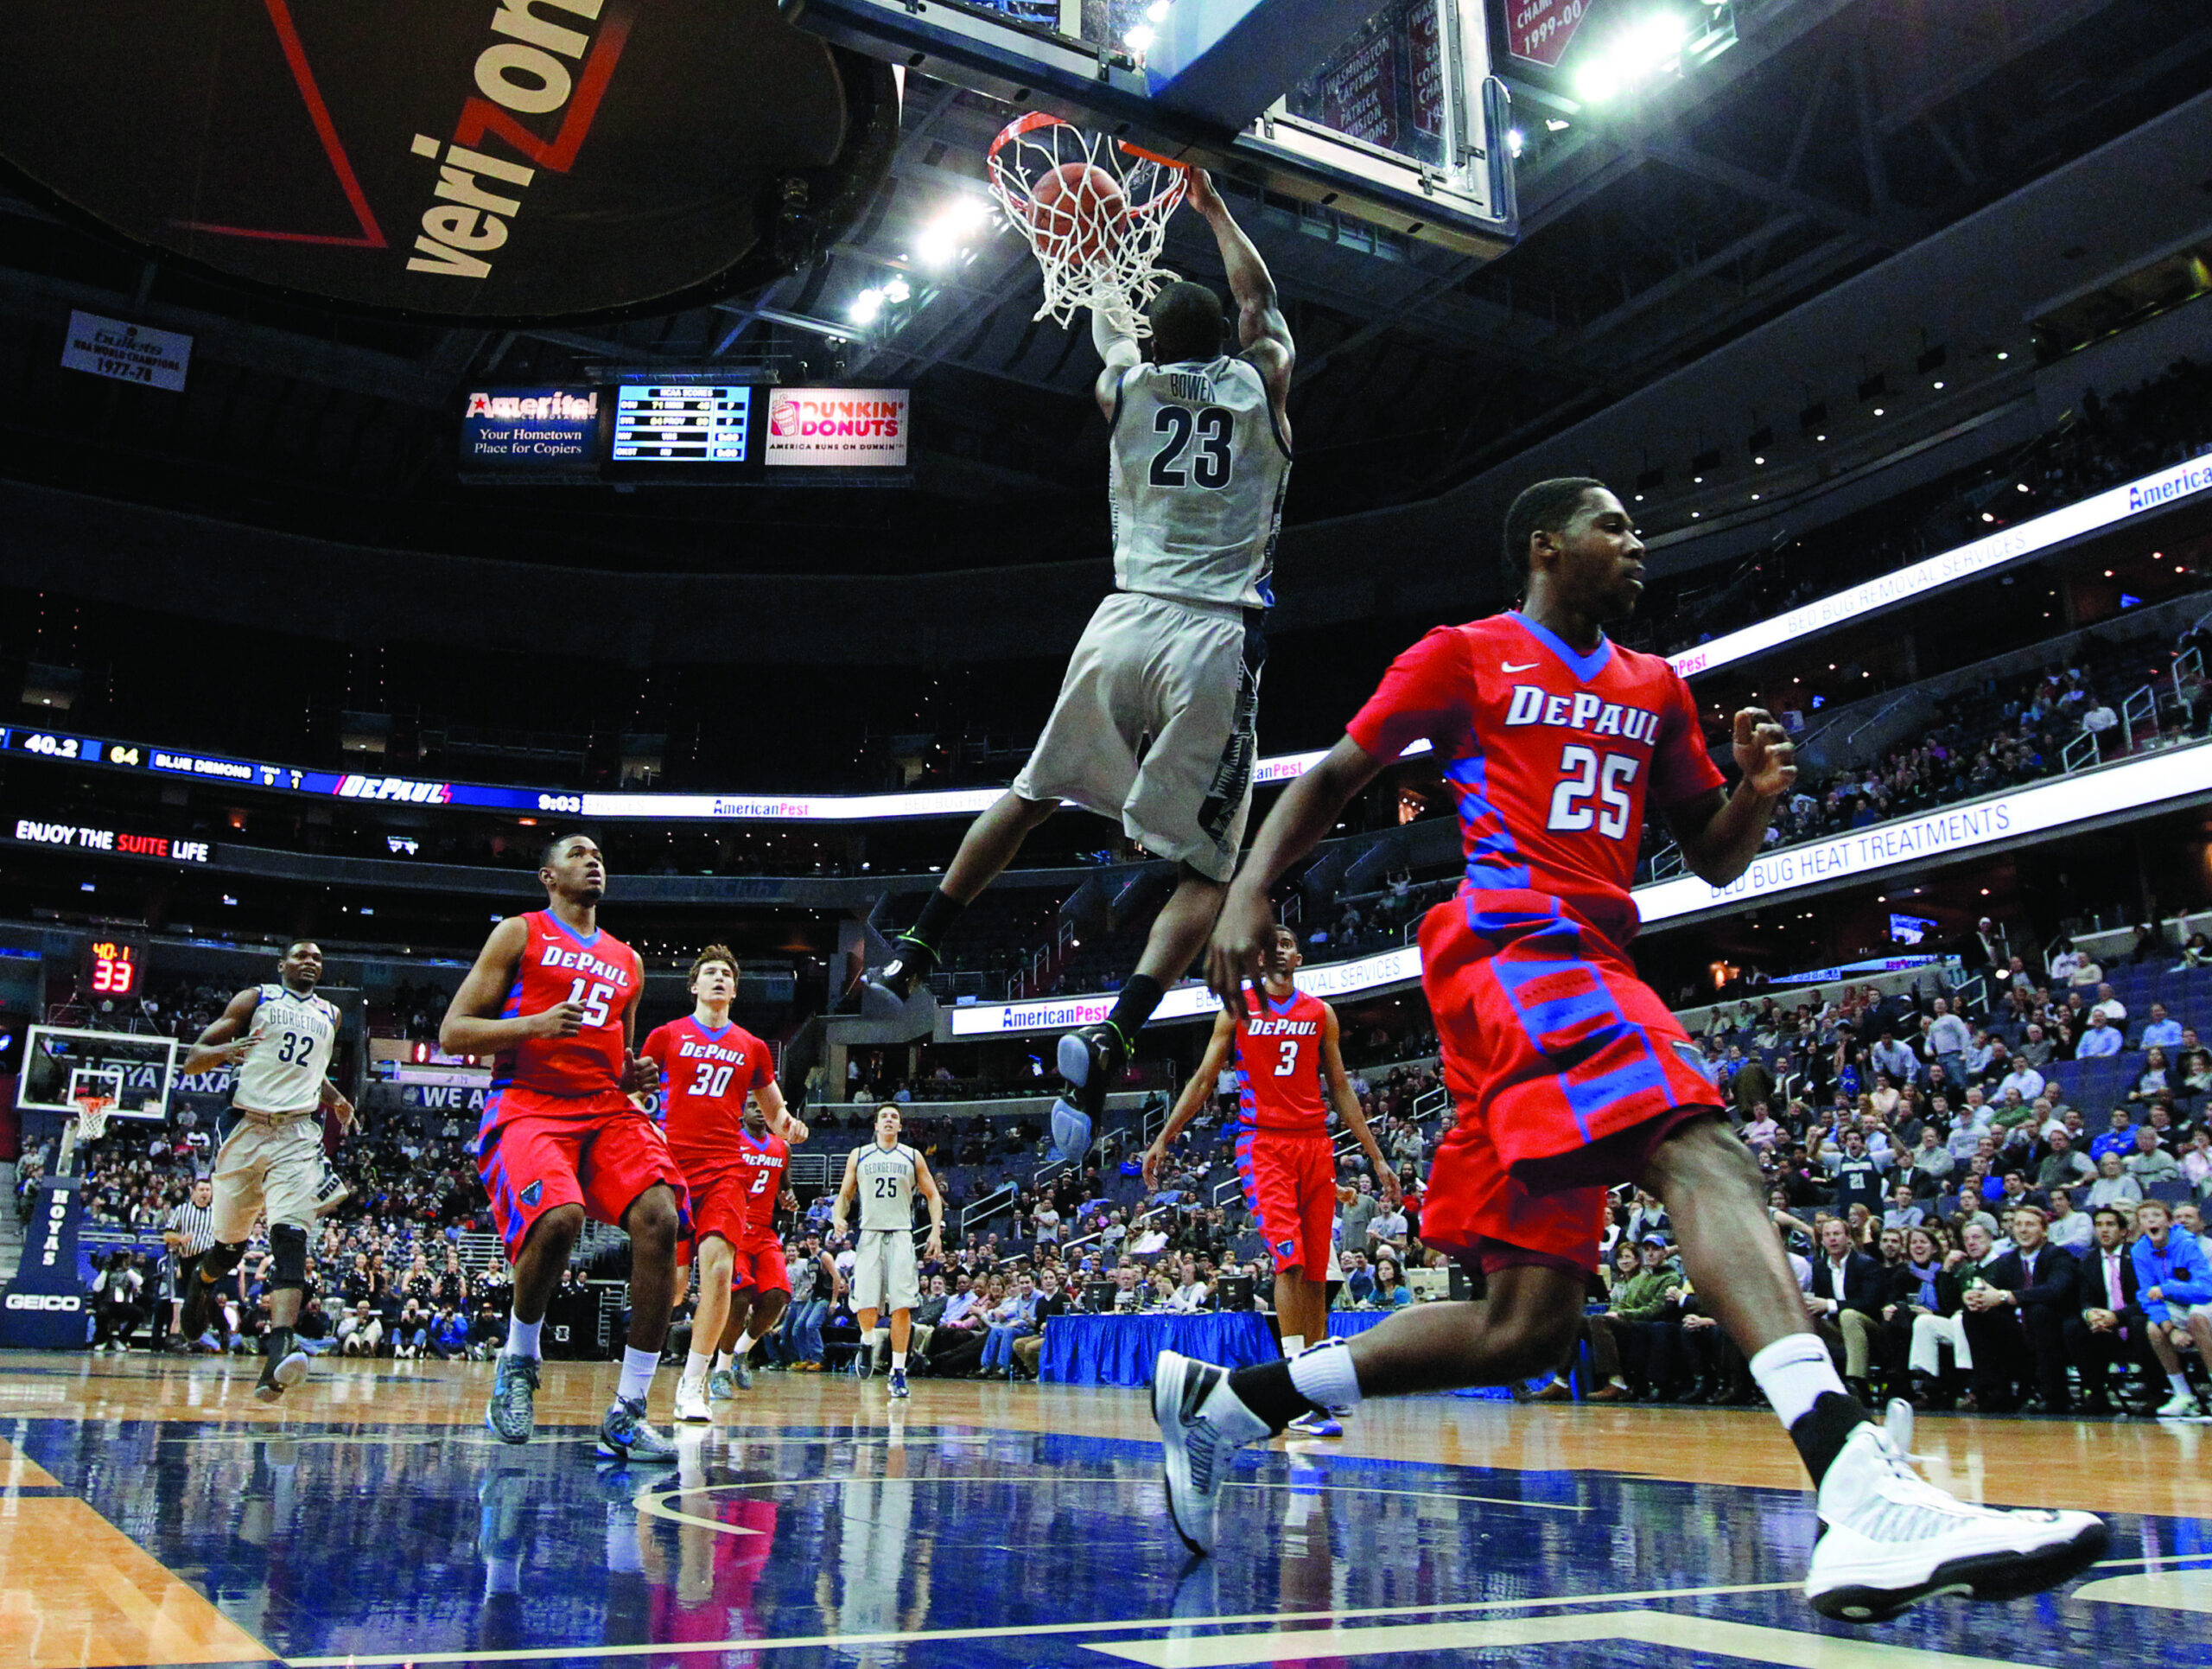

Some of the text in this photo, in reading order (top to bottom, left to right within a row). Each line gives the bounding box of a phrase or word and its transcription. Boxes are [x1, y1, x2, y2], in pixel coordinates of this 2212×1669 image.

[1524, 0, 1581, 54] 1999-00
[1326, 35, 1389, 94] WASHINGTON
[406, 0, 626, 278] verizon
[480, 429, 582, 440] Your Hometown
[801, 419, 899, 436] DONUTS
[474, 443, 582, 456] Place for Copiers
[1148, 405, 1235, 490] 23
[1859, 568, 1936, 607] REMOVAL
[1942, 531, 2027, 577] SERVICES
[24, 733, 79, 758] 40.2
[110, 745, 140, 766] 64
[155, 753, 194, 773] BLUE
[194, 757, 252, 779] DEMONS
[537, 793, 581, 812] 9:03
[713, 799, 809, 816] AmericanPest
[1547, 743, 1640, 840] 25
[16, 820, 209, 863] ENJOY THE SUITE LIFE
[1752, 857, 1794, 889] BUG
[1801, 844, 1851, 878] HEAT
[1861, 804, 2011, 859] TREATMENTS
[92, 942, 130, 962] 40.1
[92, 959, 132, 993] 33
[1341, 956, 1402, 988] SERVICES
[567, 978, 616, 1029] 15
[1002, 1005, 1109, 1028] AmericanPest
[270, 1008, 328, 1039] GEORGETOWN
[278, 1031, 315, 1068] 32
[1274, 1040, 1299, 1076] 3
[423, 1086, 464, 1108] WE
[687, 1063, 734, 1099] 30
[751, 1169, 770, 1194] 2
[864, 1162, 909, 1176] GEORGETOWN
[874, 1176, 898, 1199] 25
[42, 1188, 70, 1266] HOYAS
[5, 1293, 81, 1311] GEICO
